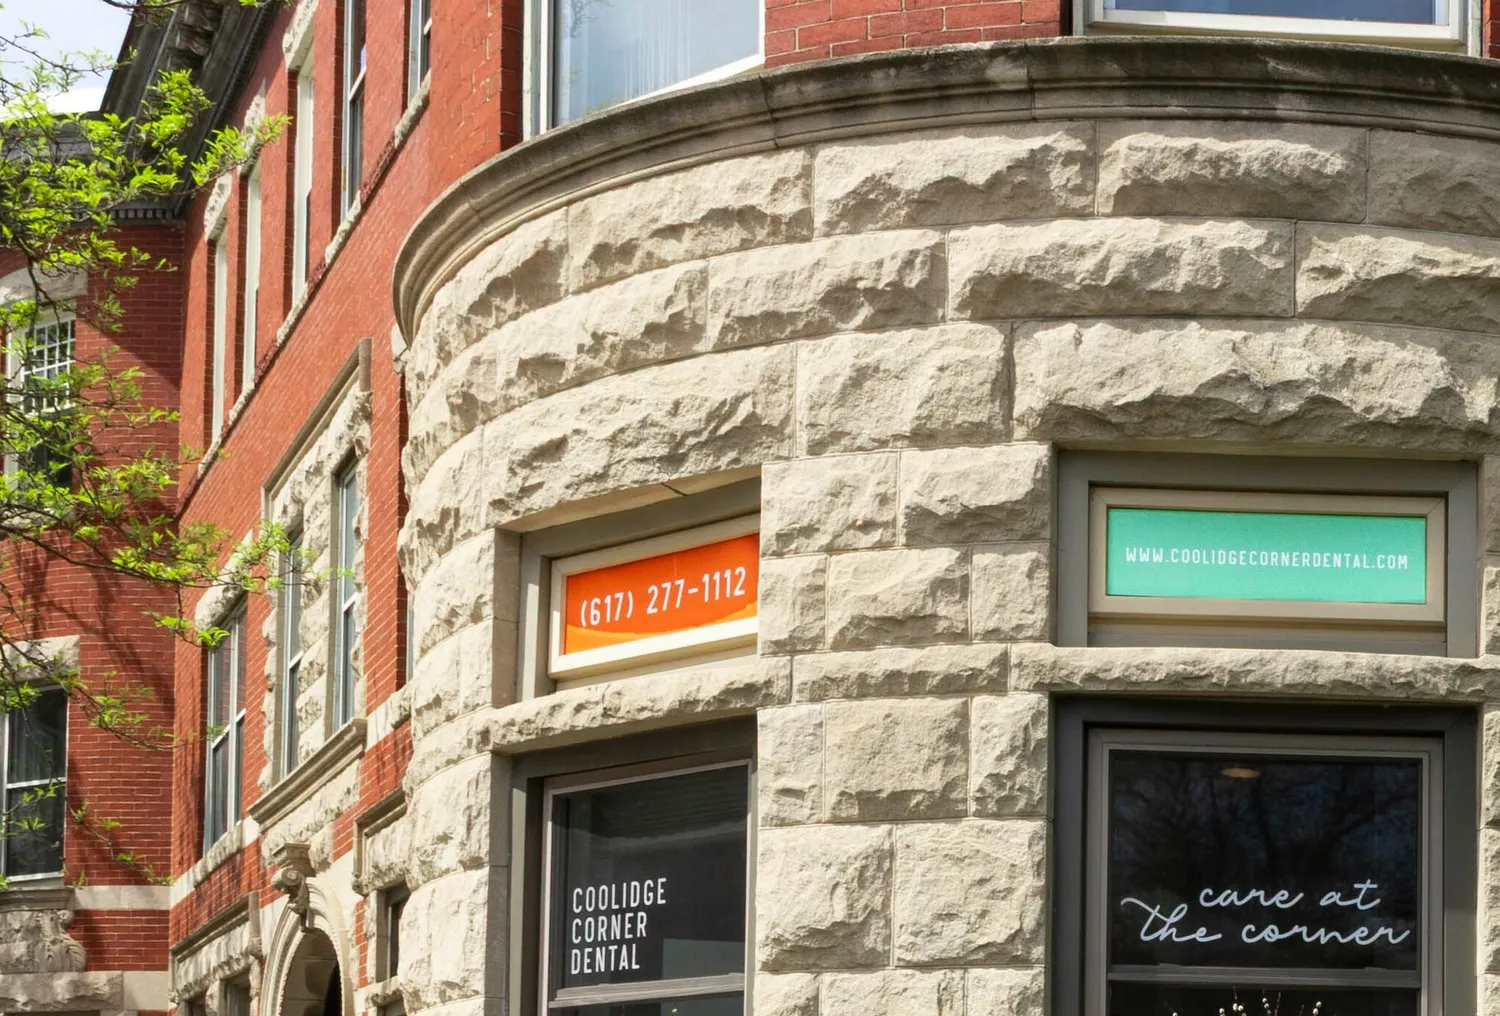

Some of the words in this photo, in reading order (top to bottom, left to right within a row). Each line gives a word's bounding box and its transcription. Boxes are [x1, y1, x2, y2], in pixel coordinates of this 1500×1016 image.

[1126, 547, 1408, 569] WWW.COOLIDGECORNERDENTAL.COM
[581, 591, 634, 627] (617)
[648, 567, 746, 614] 277-1112
[573, 877, 667, 914] COOLIDGE
[1199, 885, 1303, 909] care
[1320, 879, 1381, 909] at
[572, 912, 647, 944] CORNER
[1241, 921, 1409, 946] corner
[571, 944, 640, 975] DENTAL
